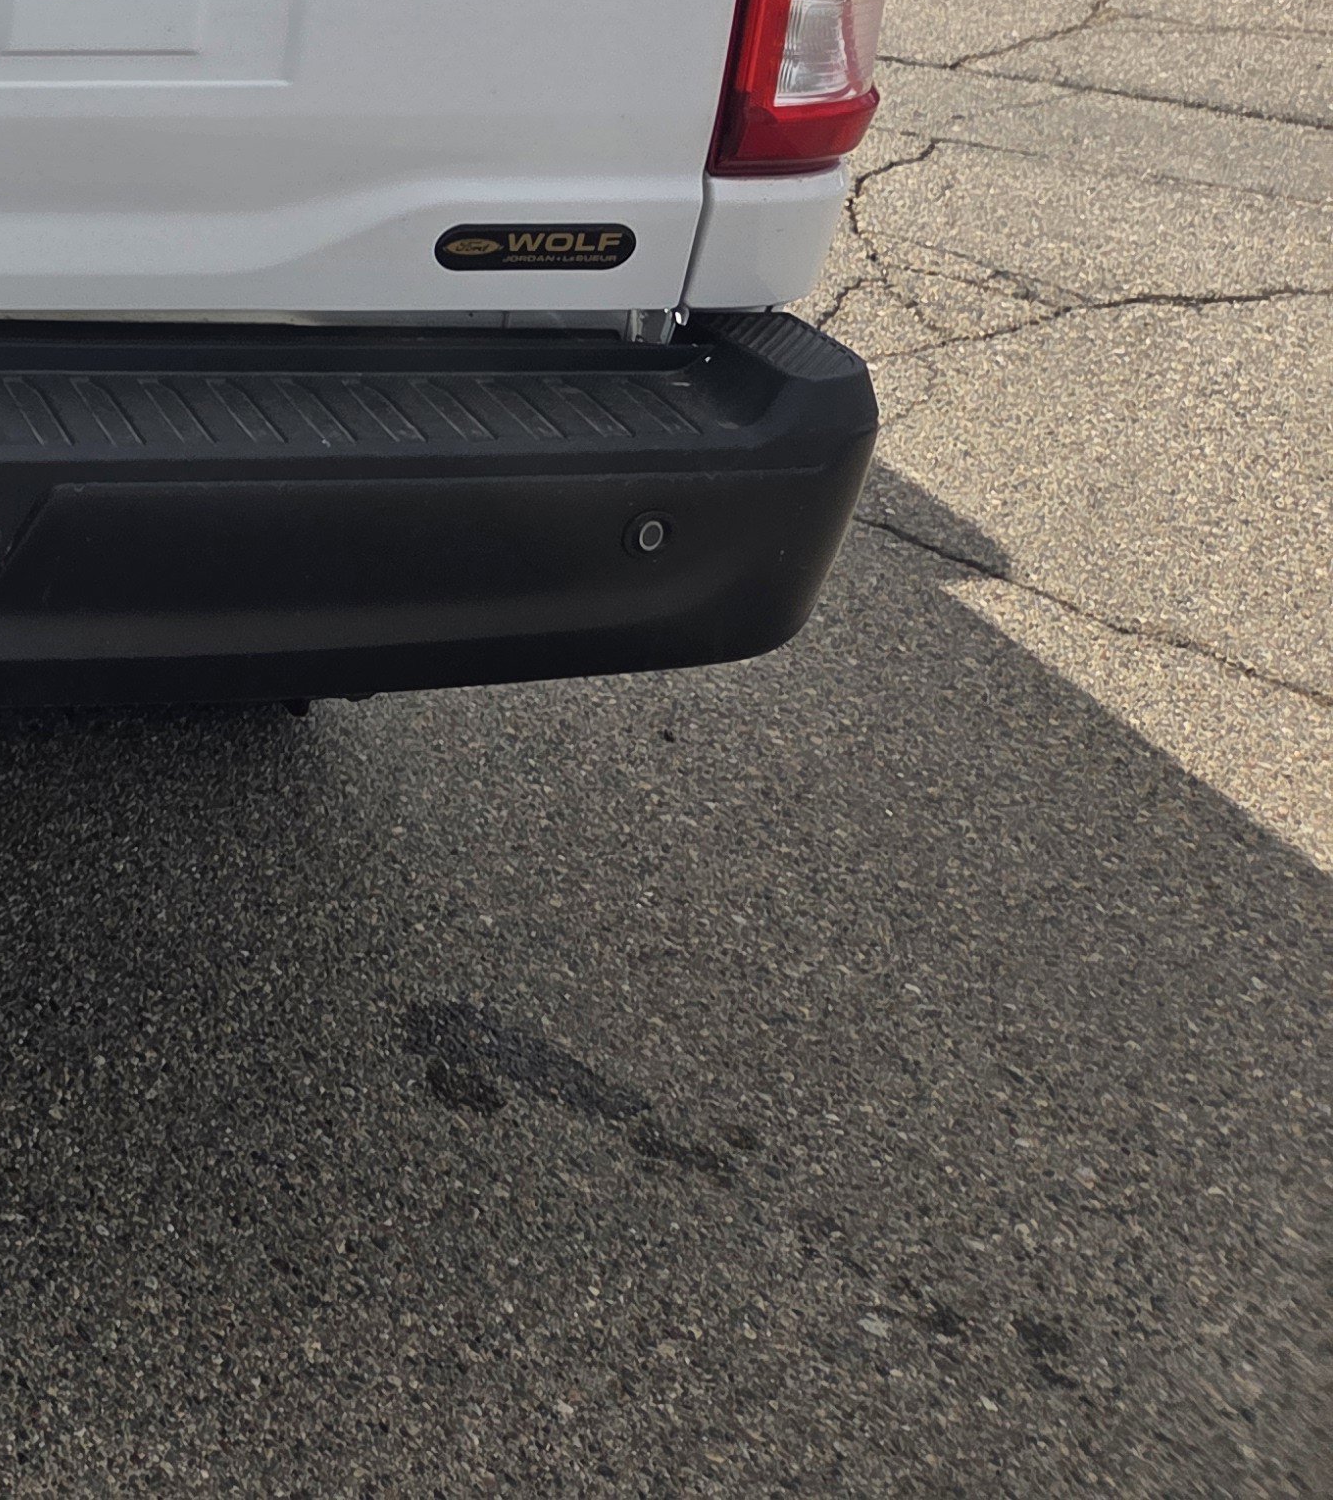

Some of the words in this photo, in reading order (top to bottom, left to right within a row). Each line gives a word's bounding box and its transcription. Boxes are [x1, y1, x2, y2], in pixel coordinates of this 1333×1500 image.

[455, 241, 491, 252] Ford
[507, 232, 623, 252] WOLF
[502, 255, 555, 263] JORDAN
